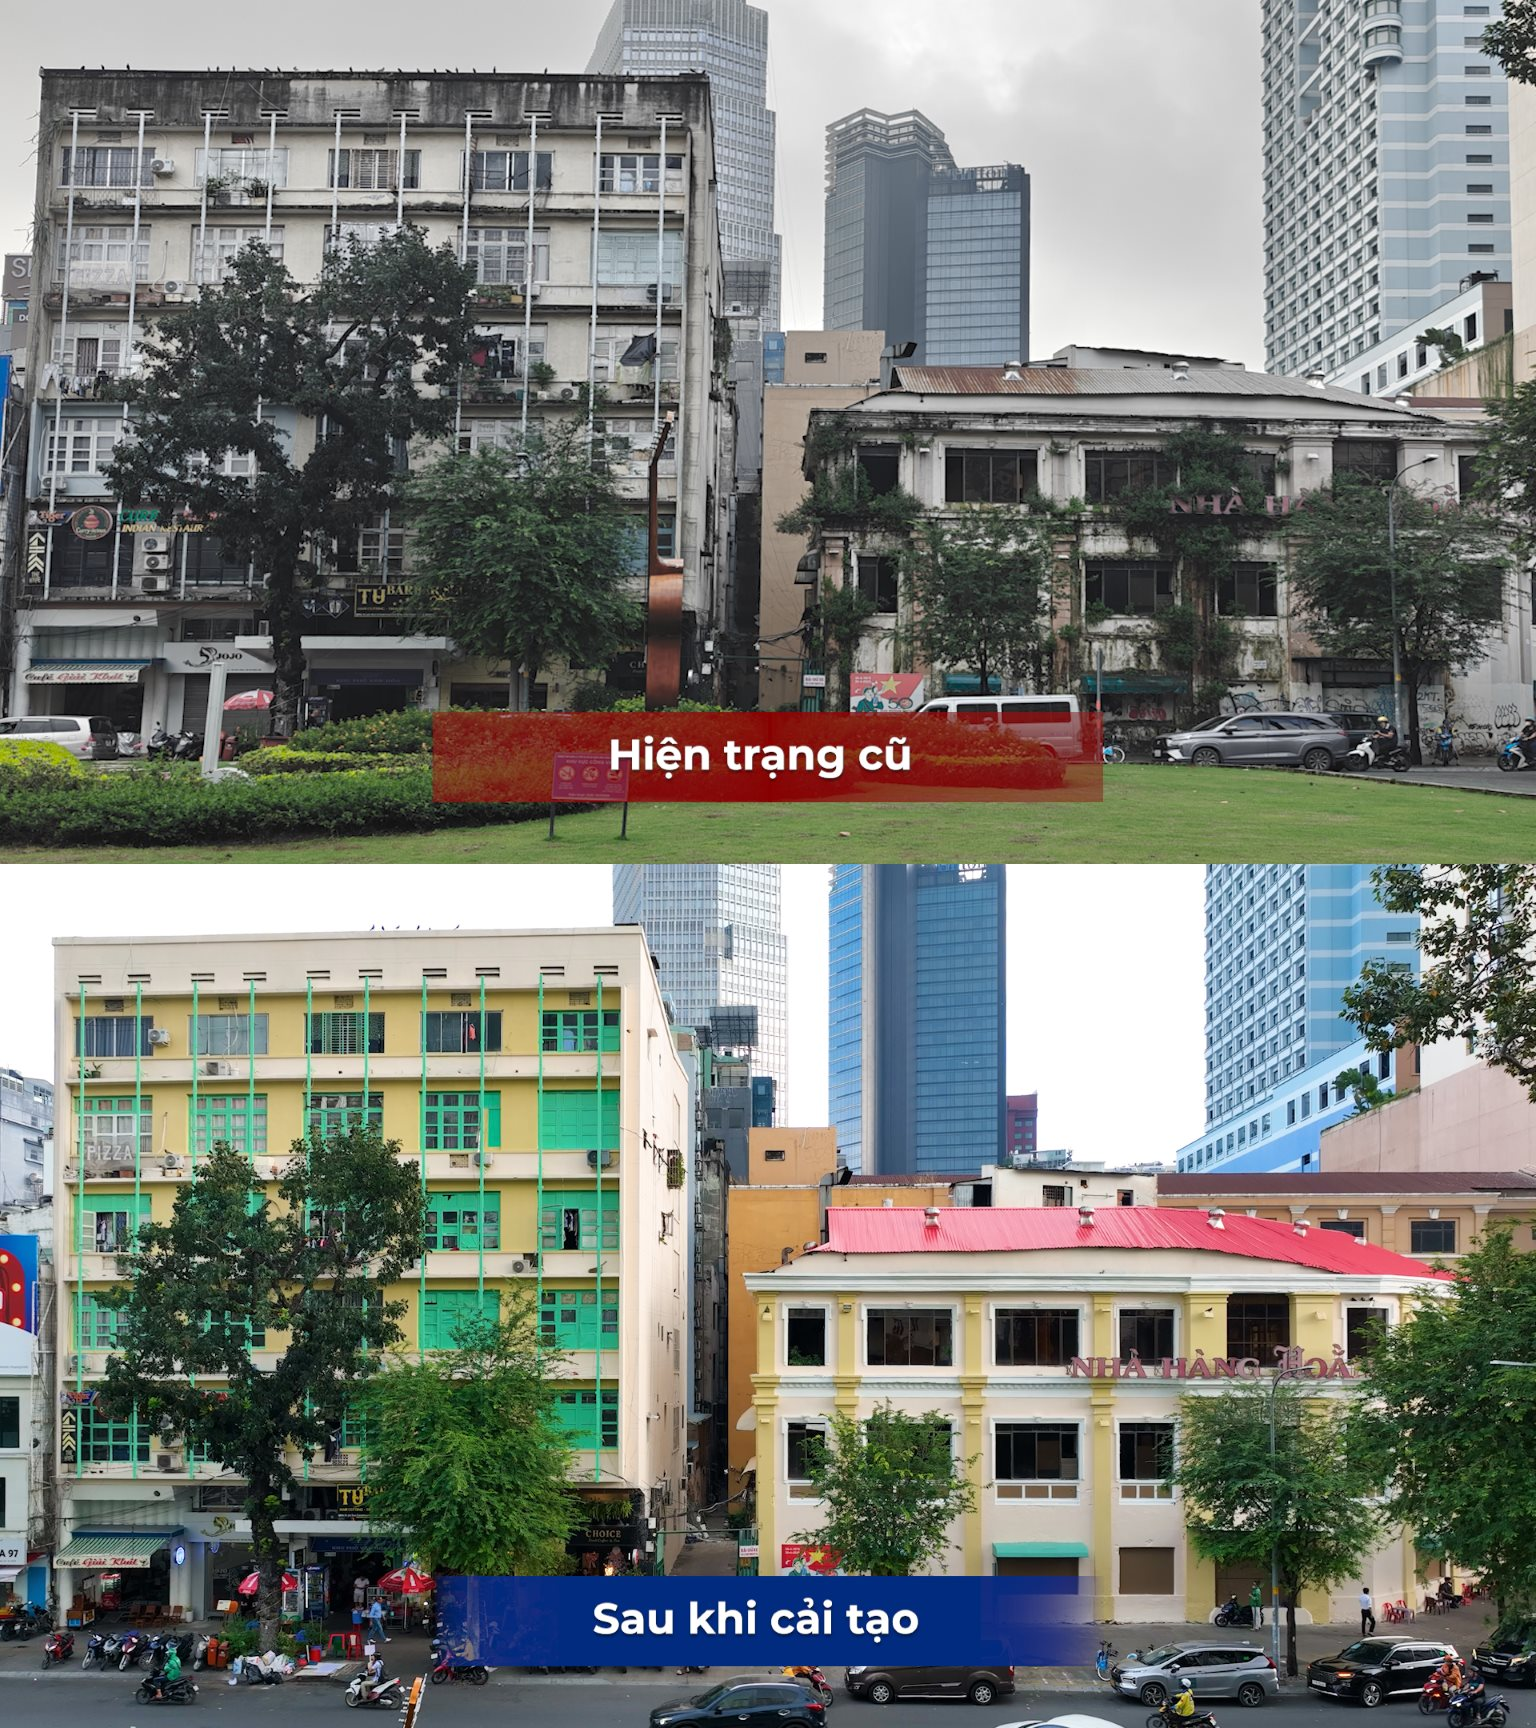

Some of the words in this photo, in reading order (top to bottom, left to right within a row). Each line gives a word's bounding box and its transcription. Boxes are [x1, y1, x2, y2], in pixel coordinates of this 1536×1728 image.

[12, 257, 32, 278] S
[1169, 486, 1247, 514] NHÀ
[121, 523, 157, 532] INDIAN
[87, 1146, 133, 1161] PIZZA
[1070, 1348, 1147, 1379] NHÀ
[1162, 1348, 1260, 1379] HÀNG
[585, 1530, 622, 1538] CHOICE
[8, 1549, 19, 1557] 97
